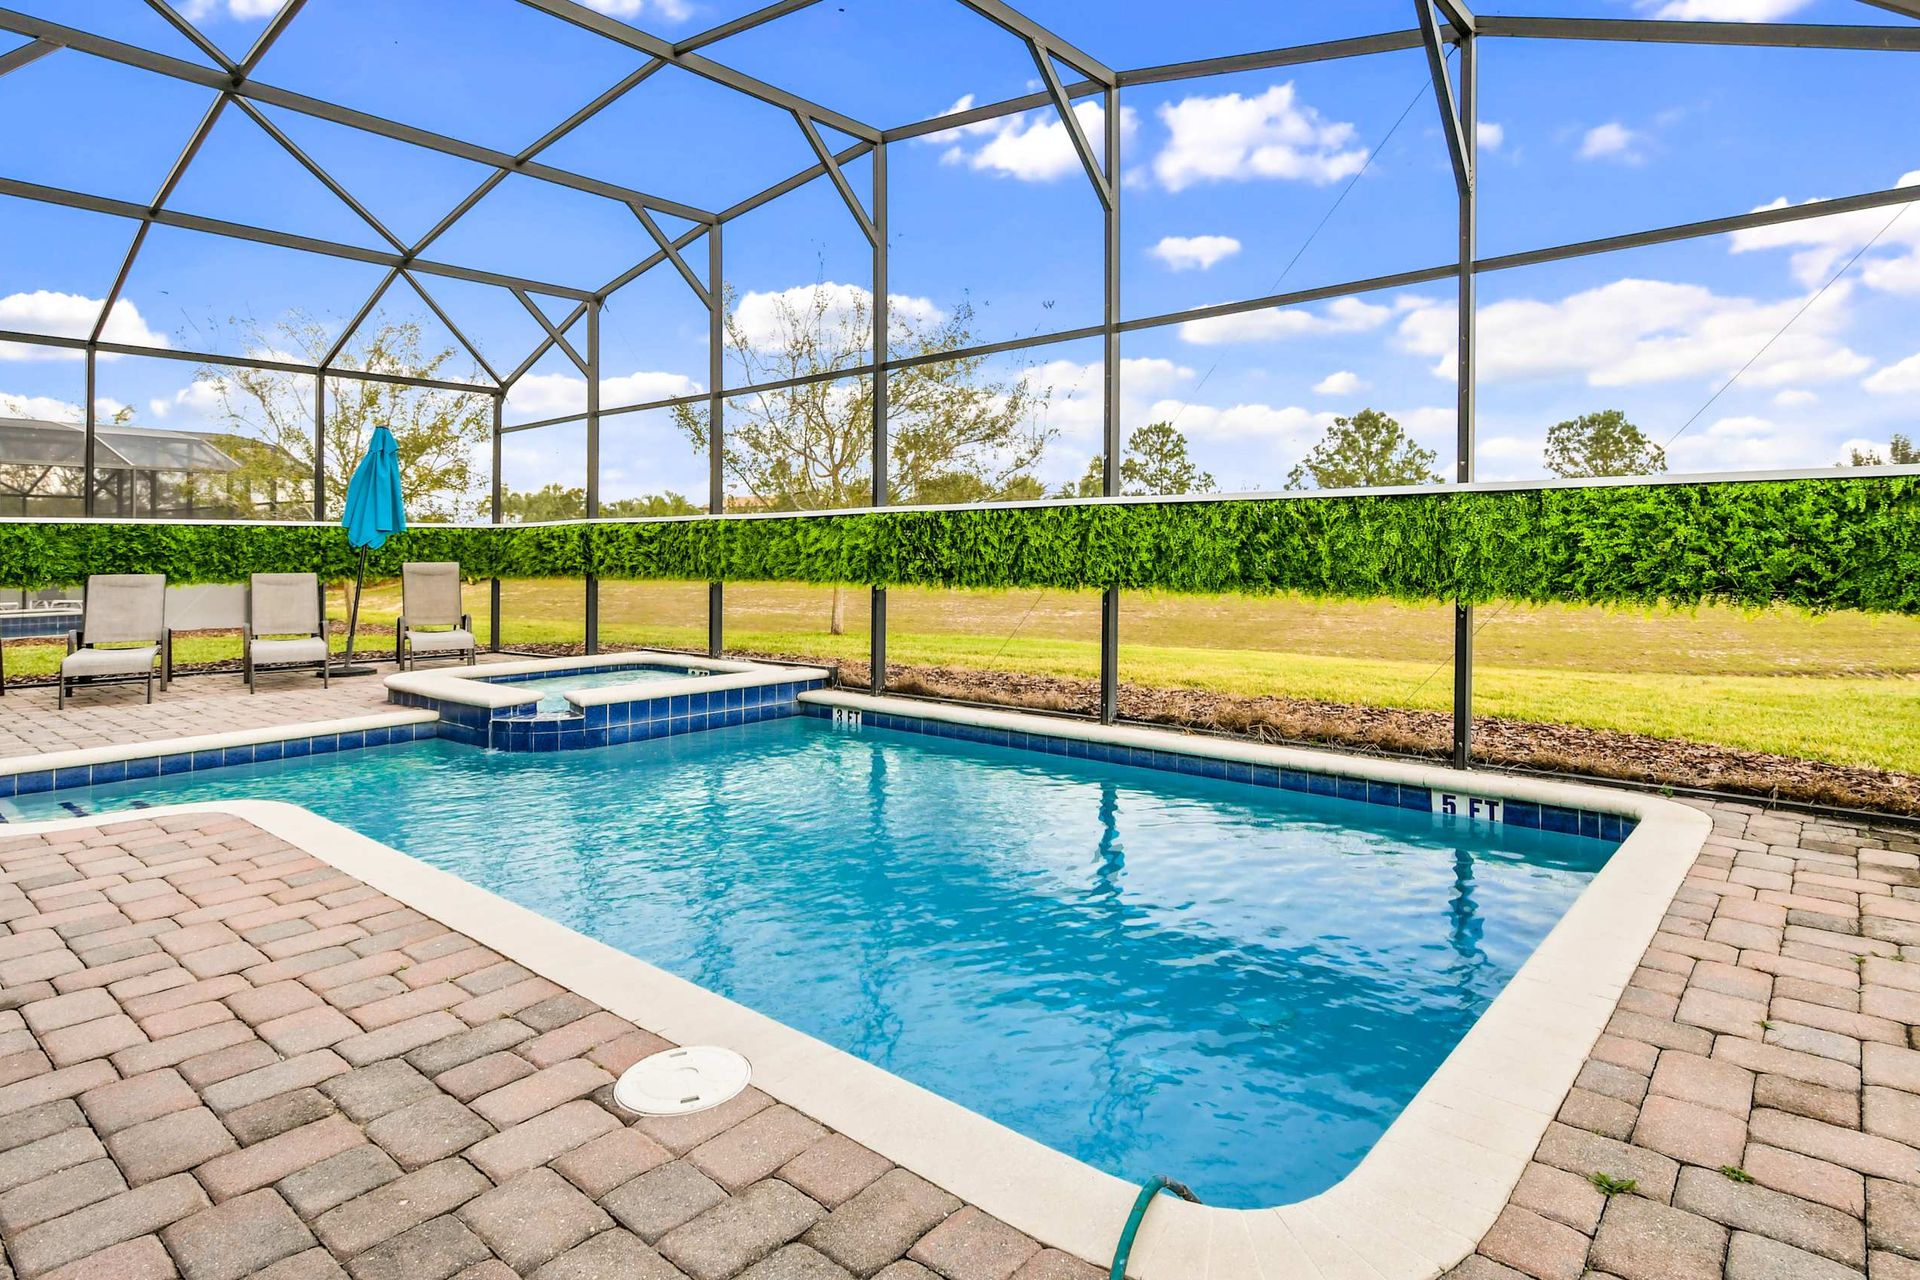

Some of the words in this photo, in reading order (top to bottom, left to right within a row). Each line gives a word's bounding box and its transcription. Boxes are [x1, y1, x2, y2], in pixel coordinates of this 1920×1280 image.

[837, 709, 843, 722] 3
[848, 710, 860, 723] FT
[1442, 794, 1456, 814] 5
